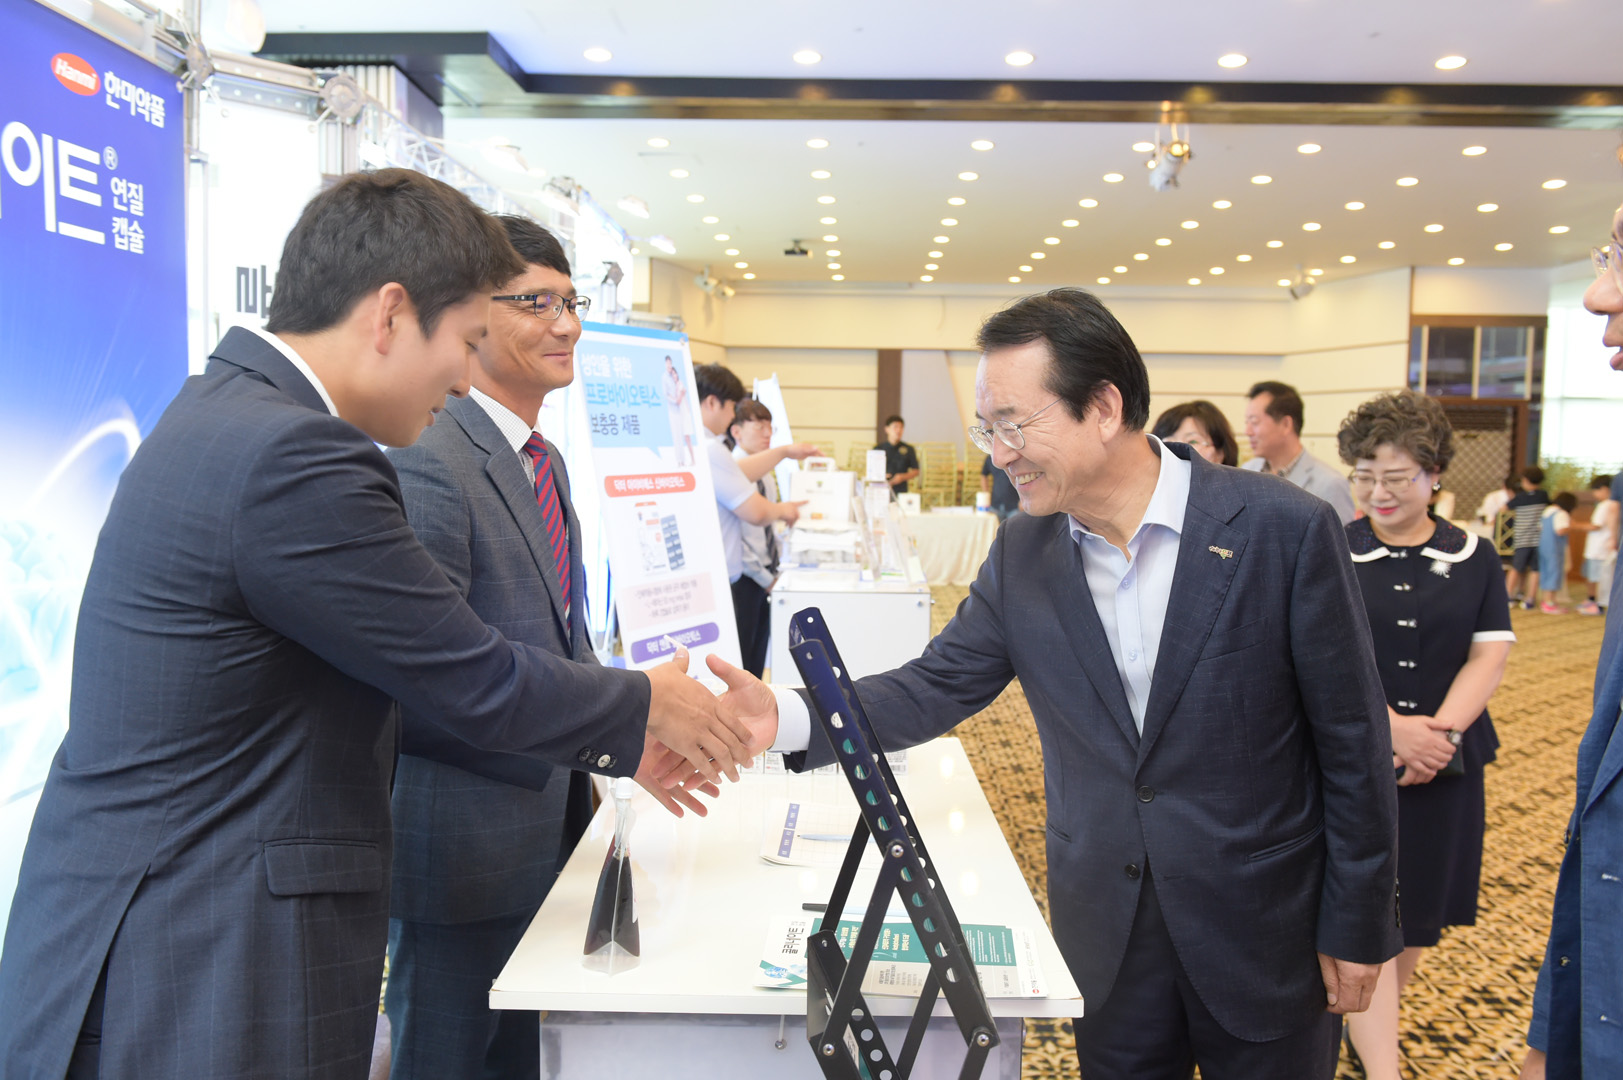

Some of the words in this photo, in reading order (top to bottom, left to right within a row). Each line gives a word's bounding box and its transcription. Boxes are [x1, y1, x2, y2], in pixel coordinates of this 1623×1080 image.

[55, 57, 98, 91] Hanmi
[104, 71, 165, 128] 한미약품
[110, 177, 144, 216] 연질
[112, 217, 145, 254] 캡슐
[612, 356, 633, 379] 위한
[586, 383, 662, 408] 프로바이오틱스
[591, 413, 619, 436] 보충용
[621, 414, 640, 436] 제품
